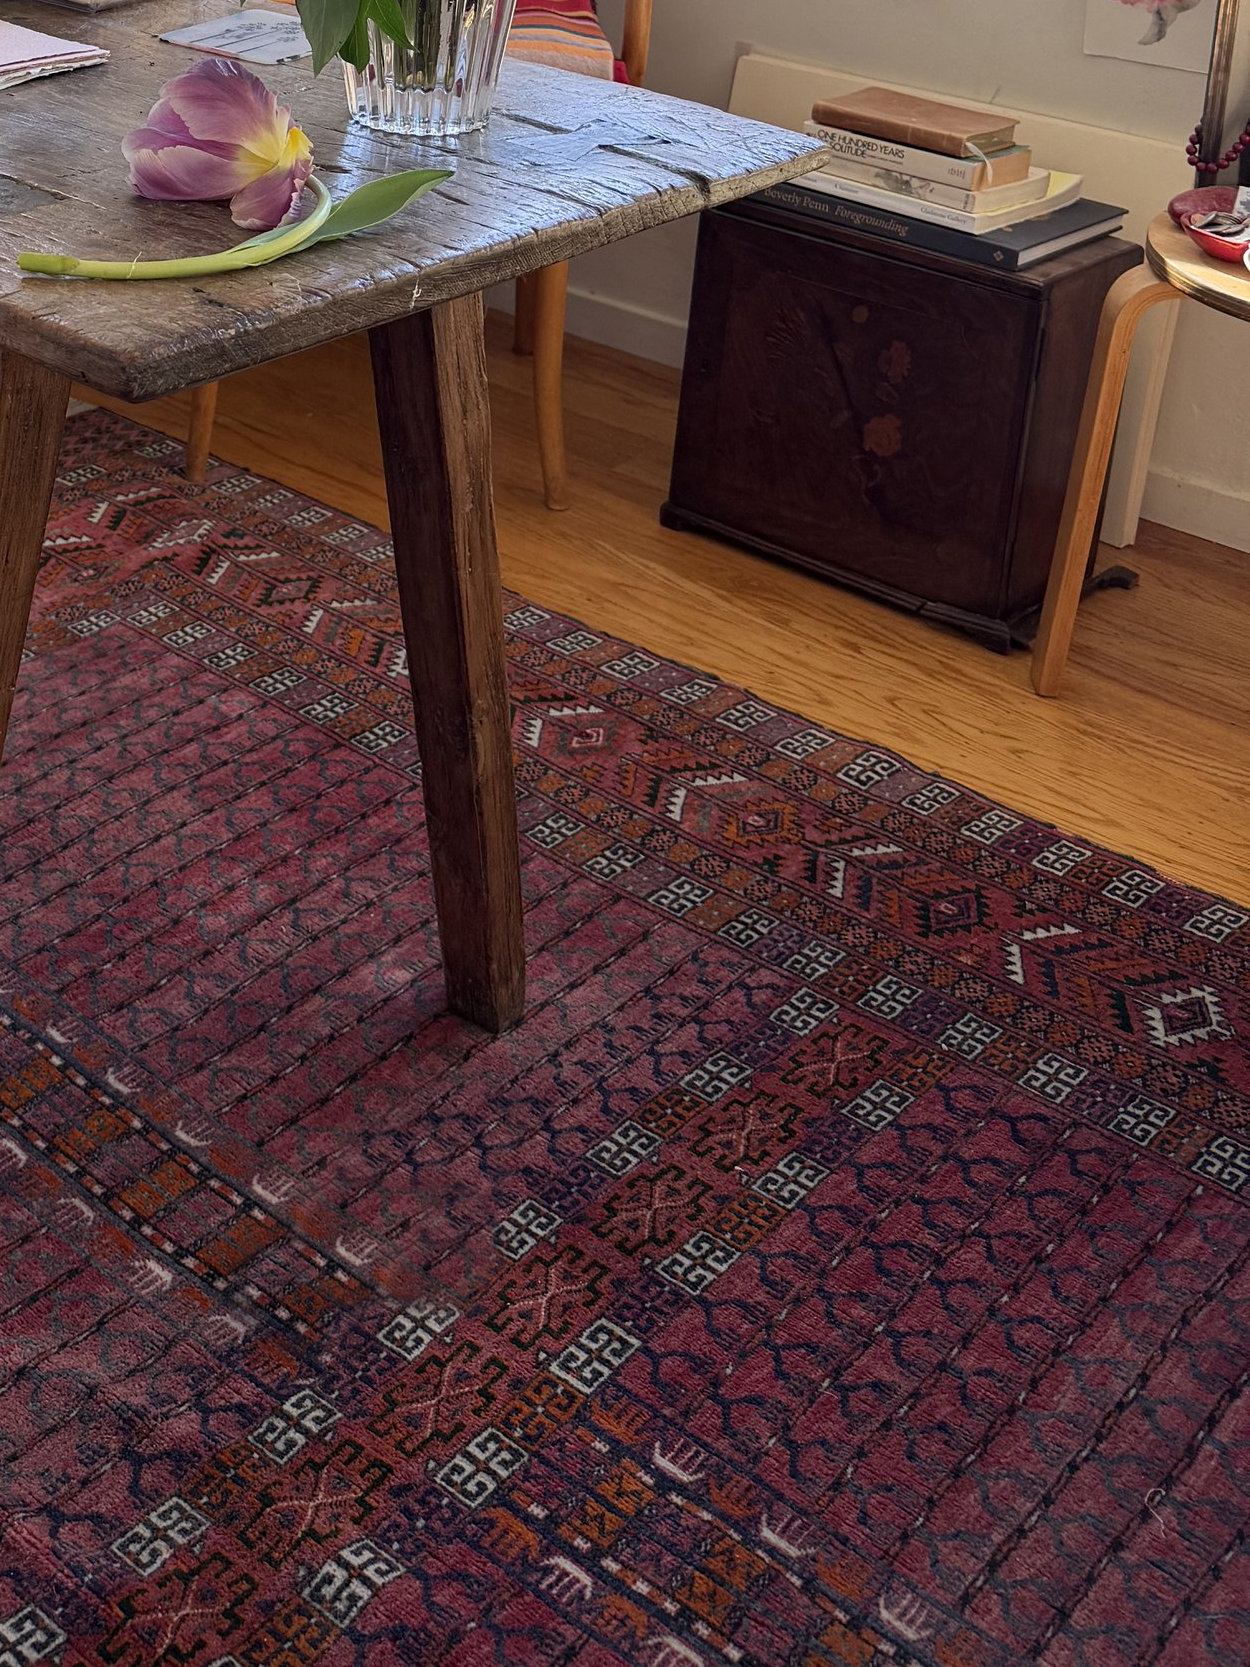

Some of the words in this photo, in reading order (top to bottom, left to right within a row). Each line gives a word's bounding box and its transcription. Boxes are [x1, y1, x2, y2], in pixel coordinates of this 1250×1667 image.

[816, 129, 837, 141] ONE
[837, 134, 878, 152] HUNDRED
[878, 145, 904, 159] YEARS
[828, 140, 867, 158] SOLITUDE
[763, 187, 800, 206] Beverly
[802, 197, 830, 212] Penn
[833, 205, 909, 237] Foregrounding
